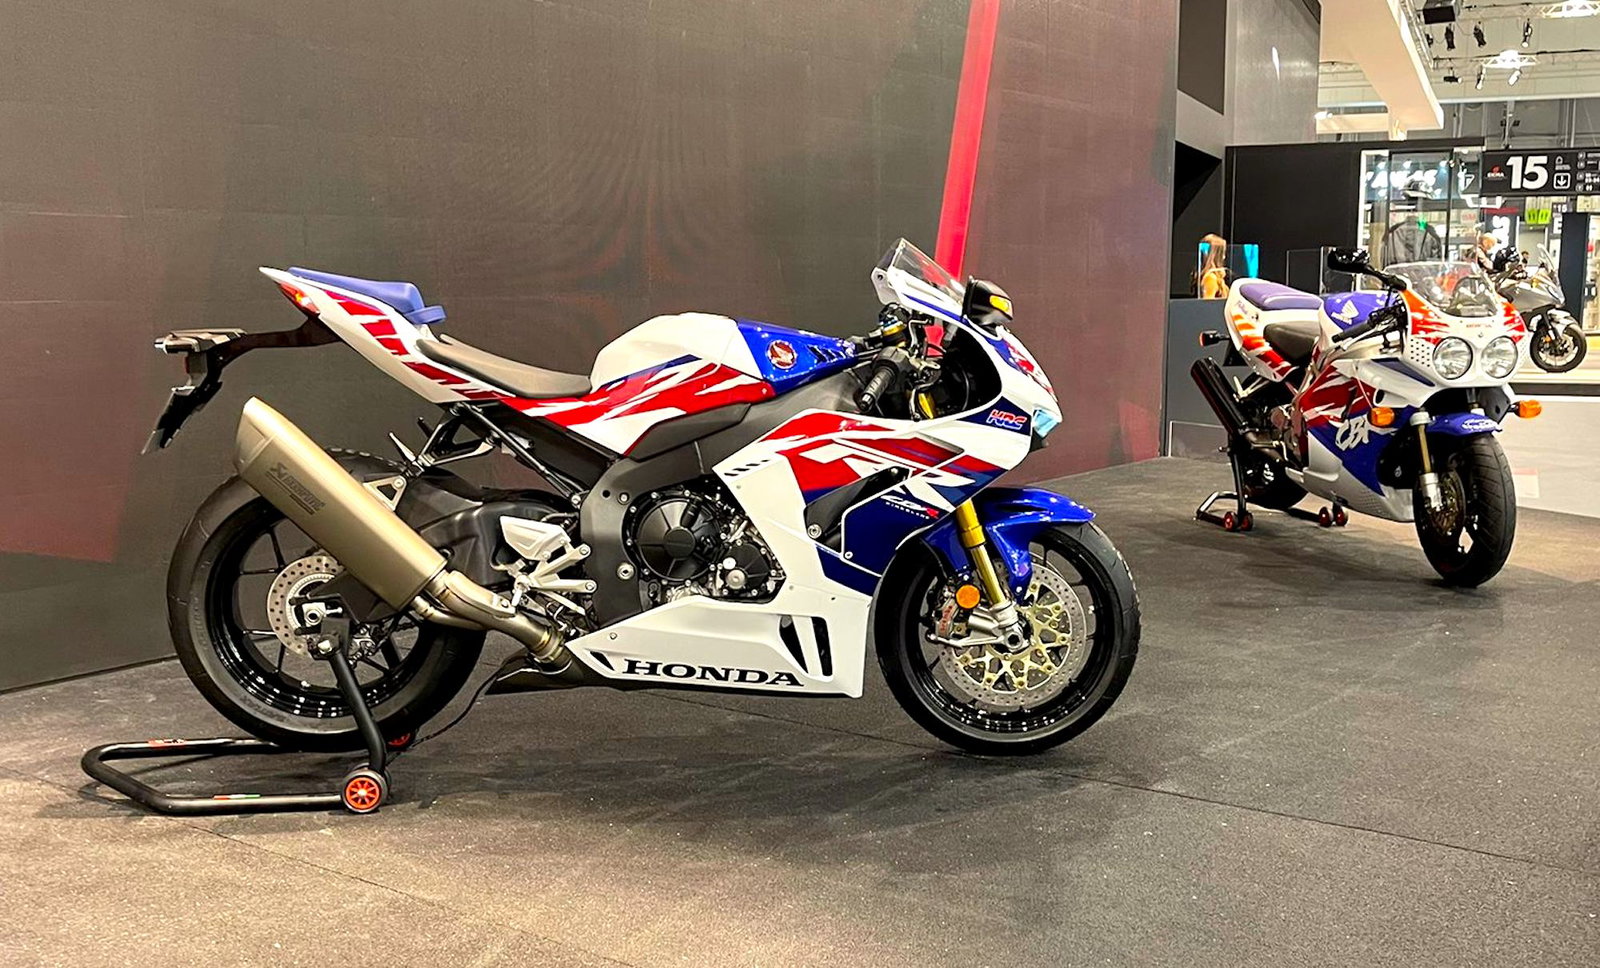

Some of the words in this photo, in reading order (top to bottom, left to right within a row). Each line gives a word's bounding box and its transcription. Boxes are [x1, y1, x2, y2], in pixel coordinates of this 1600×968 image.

[1506, 155, 1549, 190] 15
[986, 409, 1028, 430] HRC
[622, 658, 805, 687] HONDA
